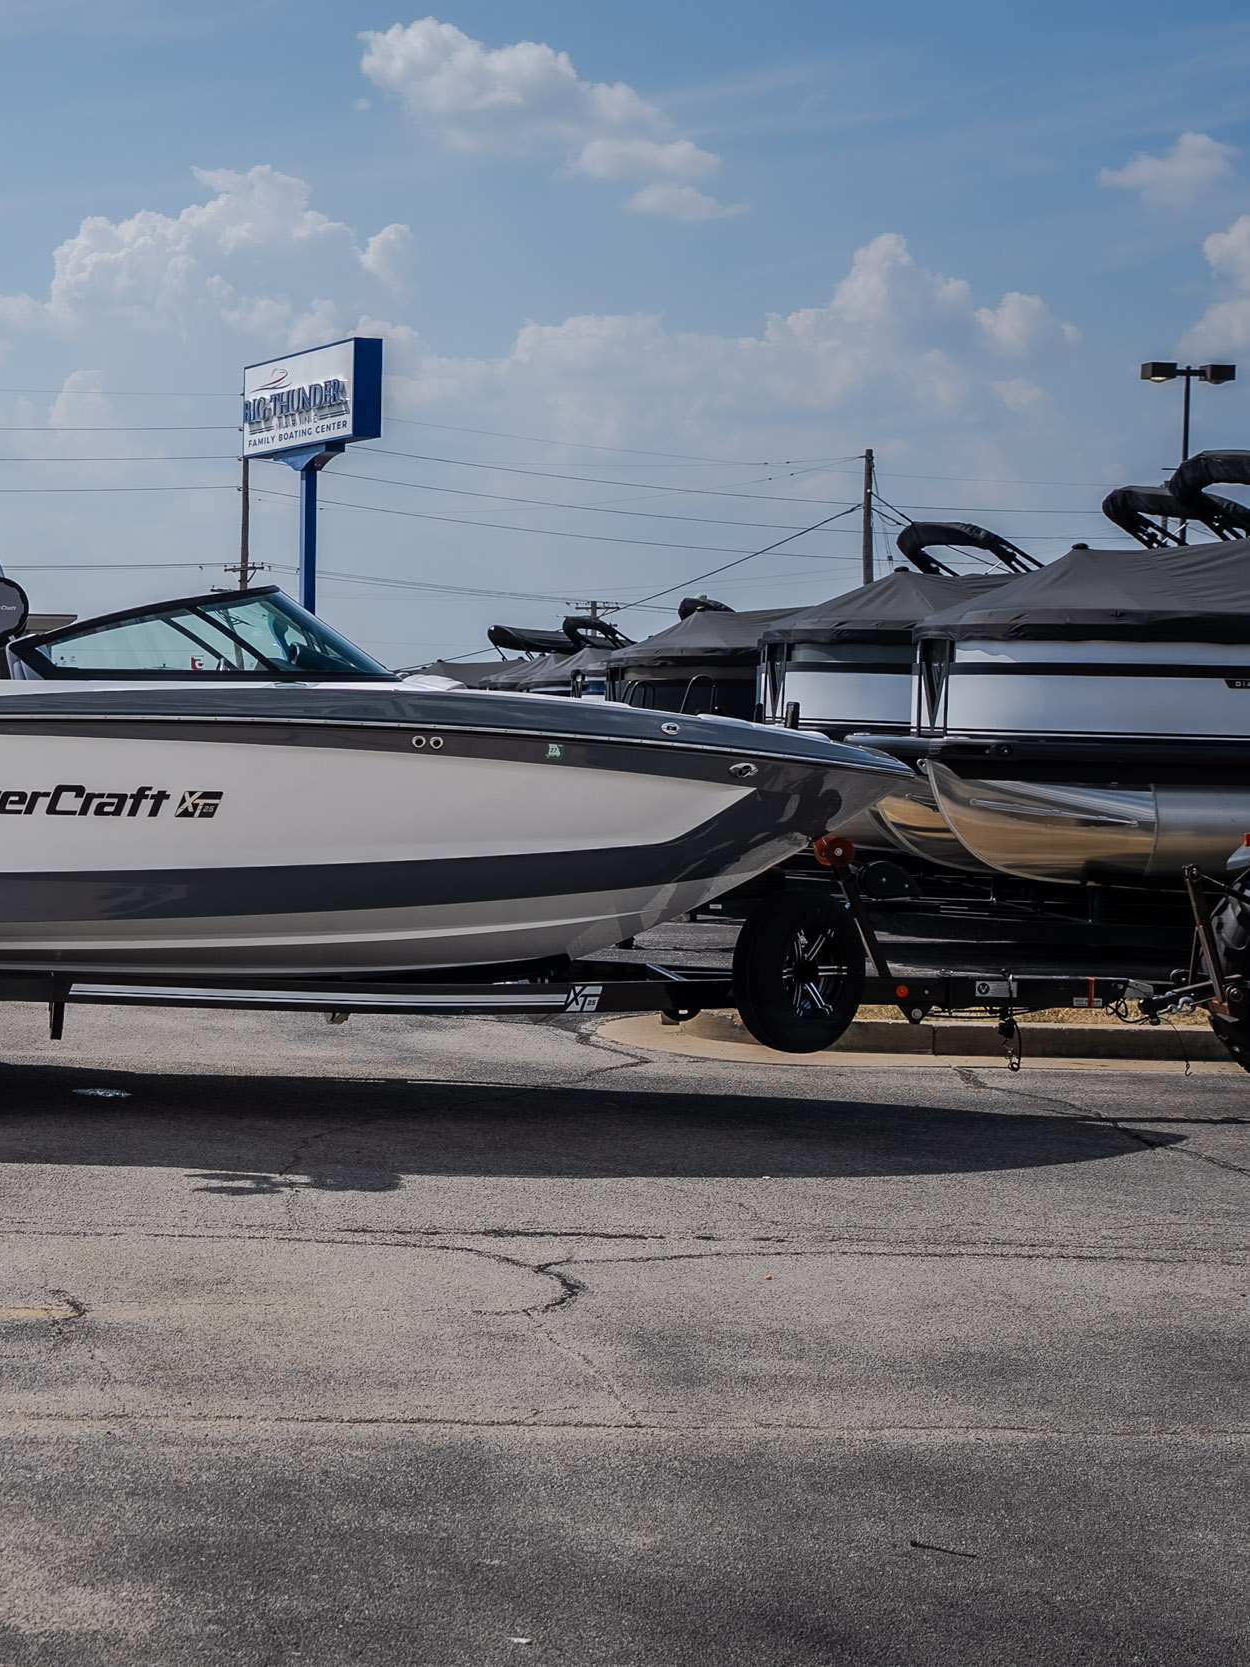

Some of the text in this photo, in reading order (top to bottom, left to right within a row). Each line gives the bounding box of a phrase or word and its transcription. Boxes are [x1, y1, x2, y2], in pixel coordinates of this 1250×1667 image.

[270, 378, 343, 417] THUNDER
[248, 420, 348, 448] FAMILY BOATING CENTER
